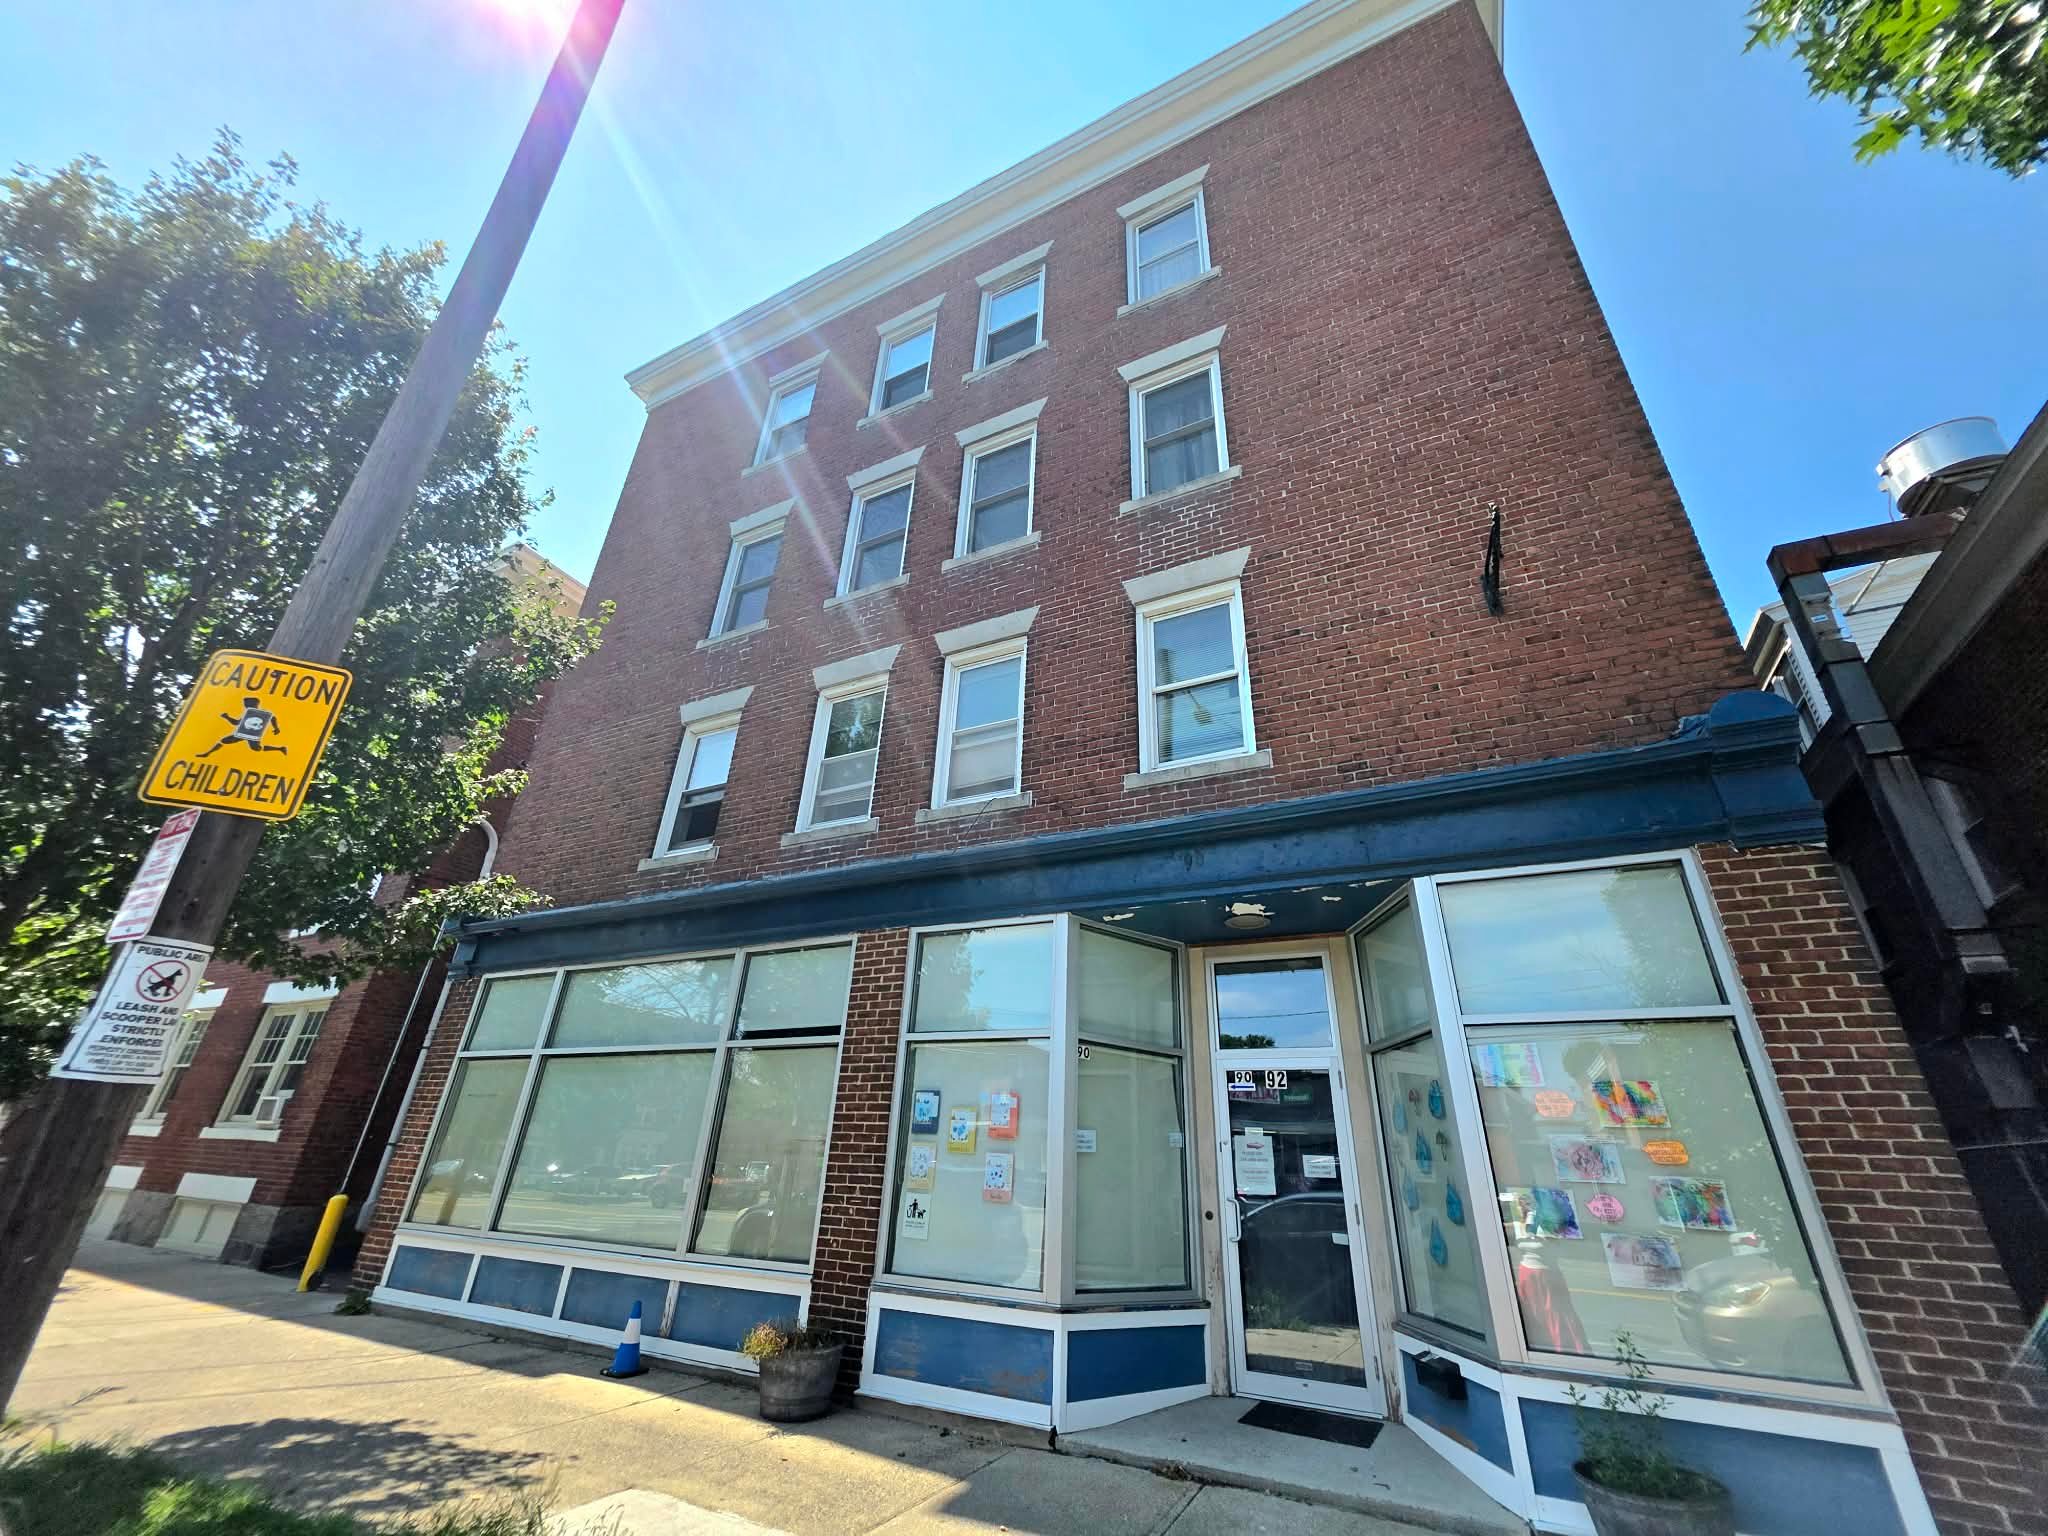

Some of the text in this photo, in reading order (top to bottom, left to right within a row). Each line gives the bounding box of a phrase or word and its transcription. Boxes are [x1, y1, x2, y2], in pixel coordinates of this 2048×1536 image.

[209, 661, 338, 705] CAUTION
[165, 760, 295, 805] CHILDREN
[137, 946, 183, 959] PUBLIC
[115, 1002, 160, 1013] LEASH
[101, 1012, 162, 1024] SCOOPER
[111, 1024, 166, 1036] STRICTLY
[1078, 1047, 1090, 1058] 90
[1236, 1072, 1252, 1083] 90
[1266, 1071, 1287, 1088] 92
